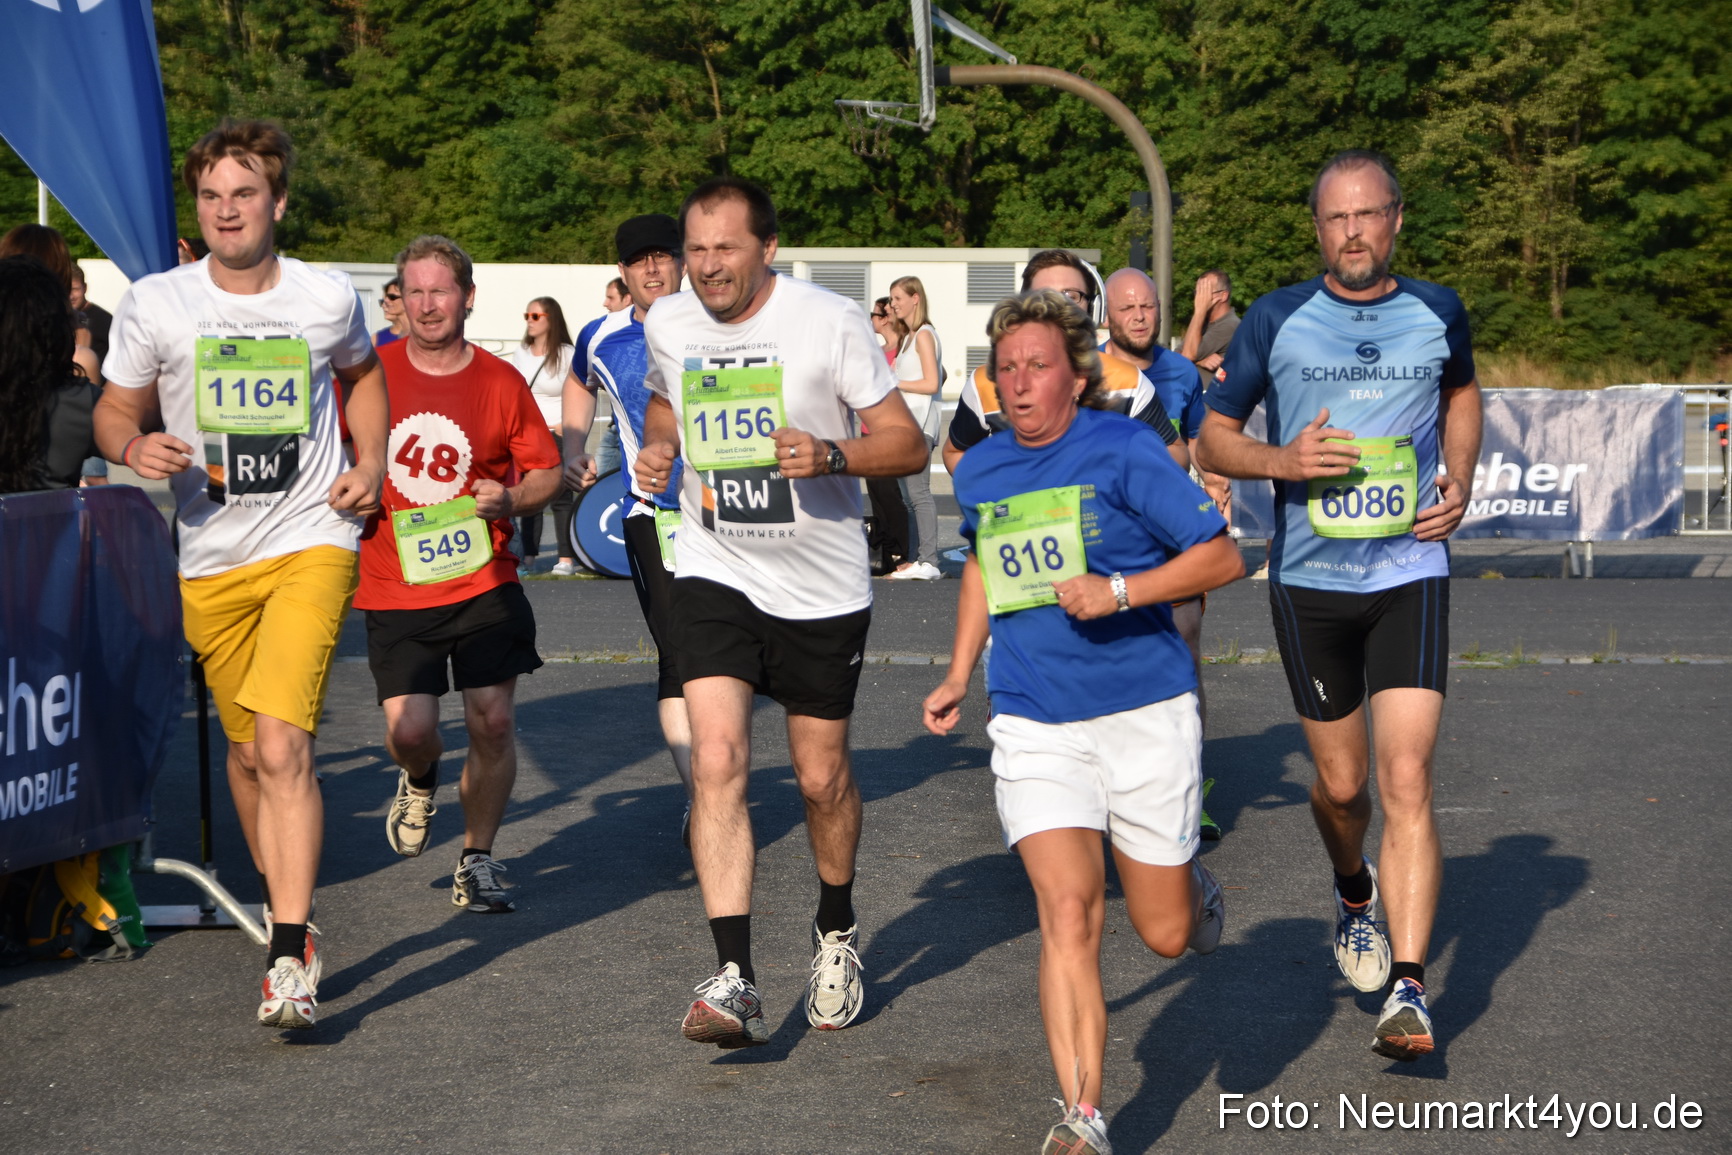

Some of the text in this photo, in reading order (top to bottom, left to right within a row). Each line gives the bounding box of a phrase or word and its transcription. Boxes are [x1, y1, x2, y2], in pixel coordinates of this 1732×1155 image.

[216, 321, 238, 329] NEUE
[242, 320, 300, 329] WOHNFORMEL
[701, 344, 721, 352] NEUE
[725, 342, 778, 352] WOHNFORMEL
[1301, 366, 1433, 382] SCHABMÜLLER
[208, 377, 298, 408] 1164
[1349, 389, 1384, 400] TEAM
[693, 406, 776, 442] 1156
[237, 454, 280, 482] RW
[394, 433, 460, 483] 48
[722, 479, 769, 509] RW
[1321, 484, 1405, 519] 6086
[417, 530, 472, 564] 549
[719, 526, 797, 539] RAUMWERK
[998, 536, 1065, 578] 818
[1303, 552, 1422, 574] www.schabmueller.de
